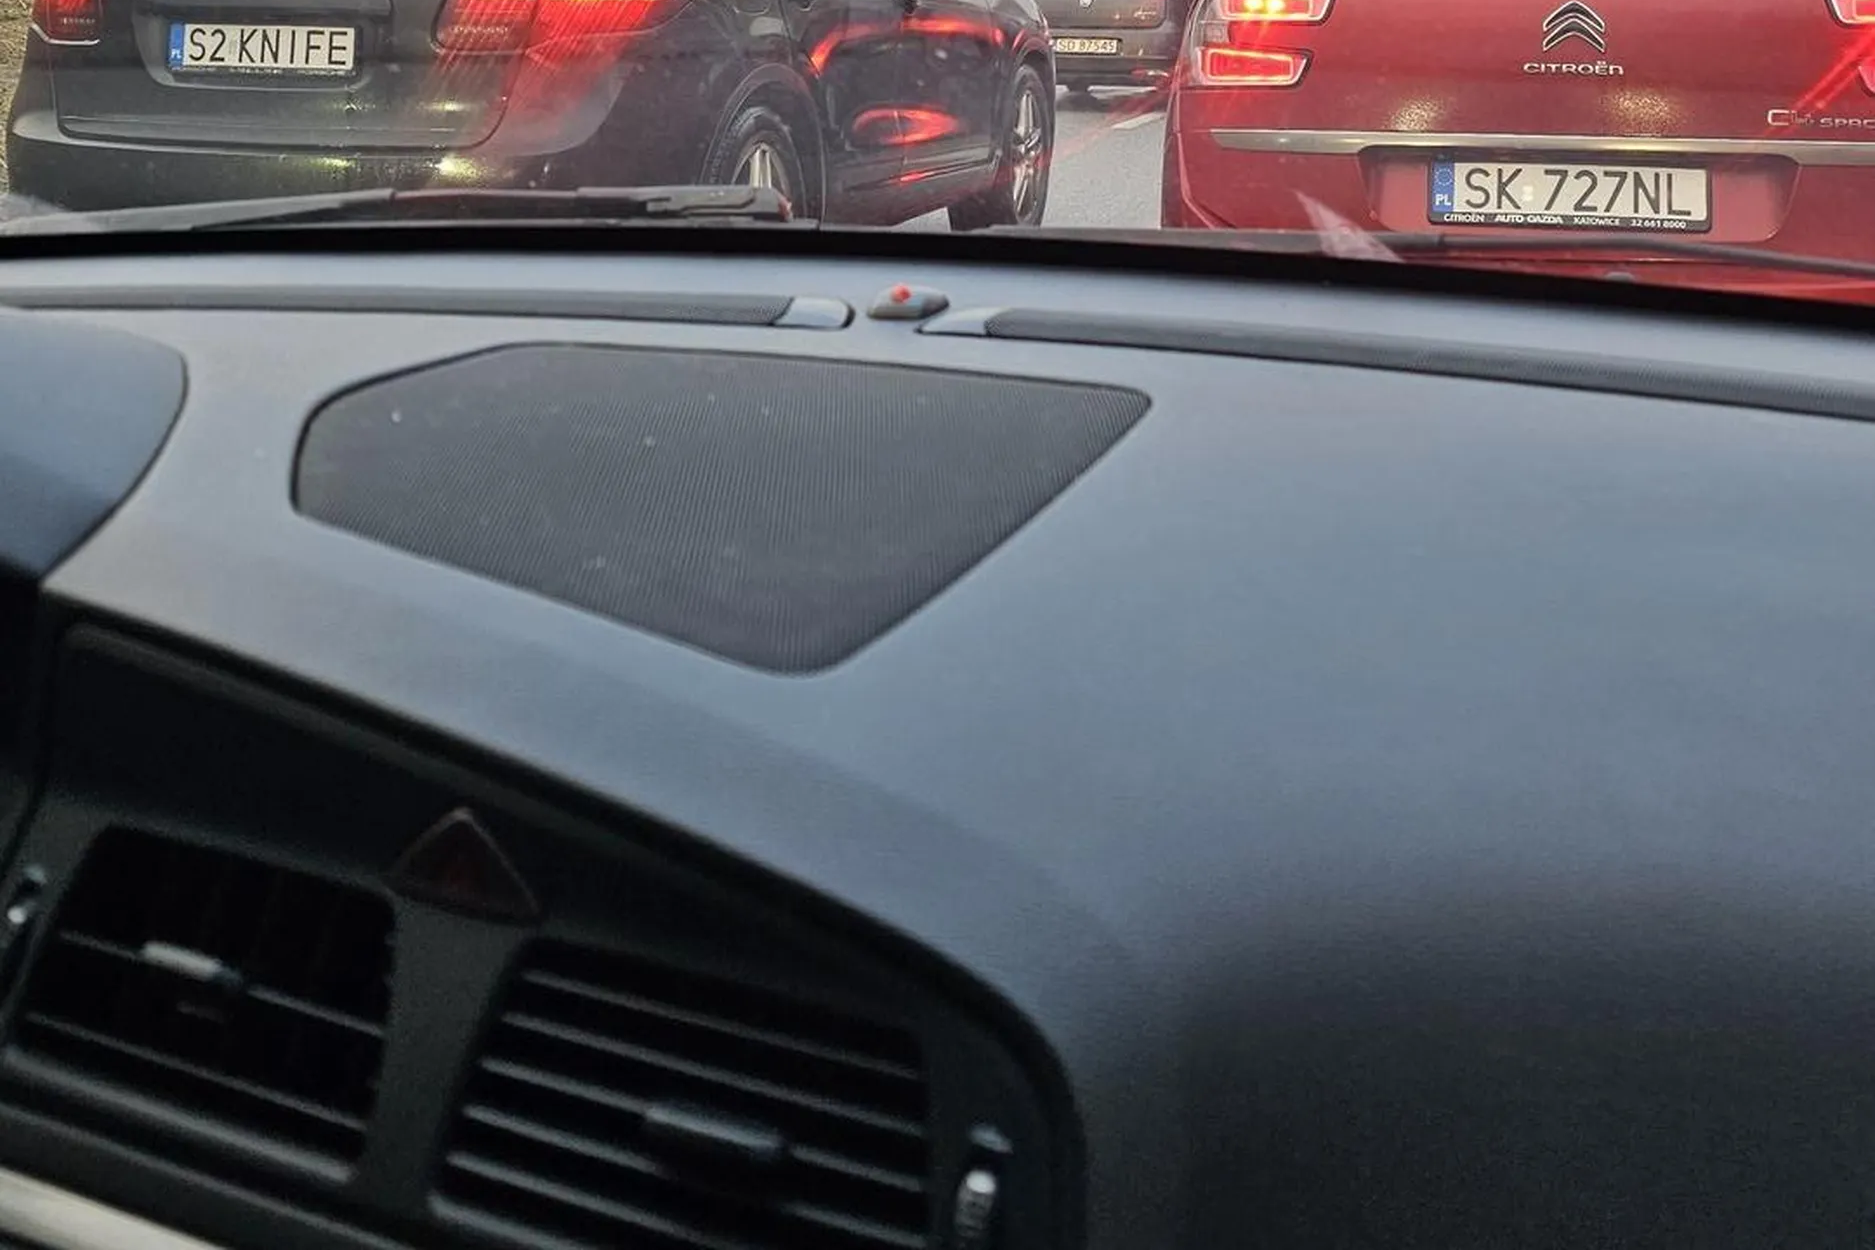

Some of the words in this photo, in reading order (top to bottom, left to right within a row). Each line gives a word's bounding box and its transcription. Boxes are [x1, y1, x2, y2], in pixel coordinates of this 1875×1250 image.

[189, 28, 226, 62] S2
[238, 29, 348, 65] KNIFE
[1435, 194, 1452, 206] PL
[1465, 168, 1522, 209] SK
[1543, 169, 1692, 216] 727NL
[1495, 214, 1524, 223] AUTO
